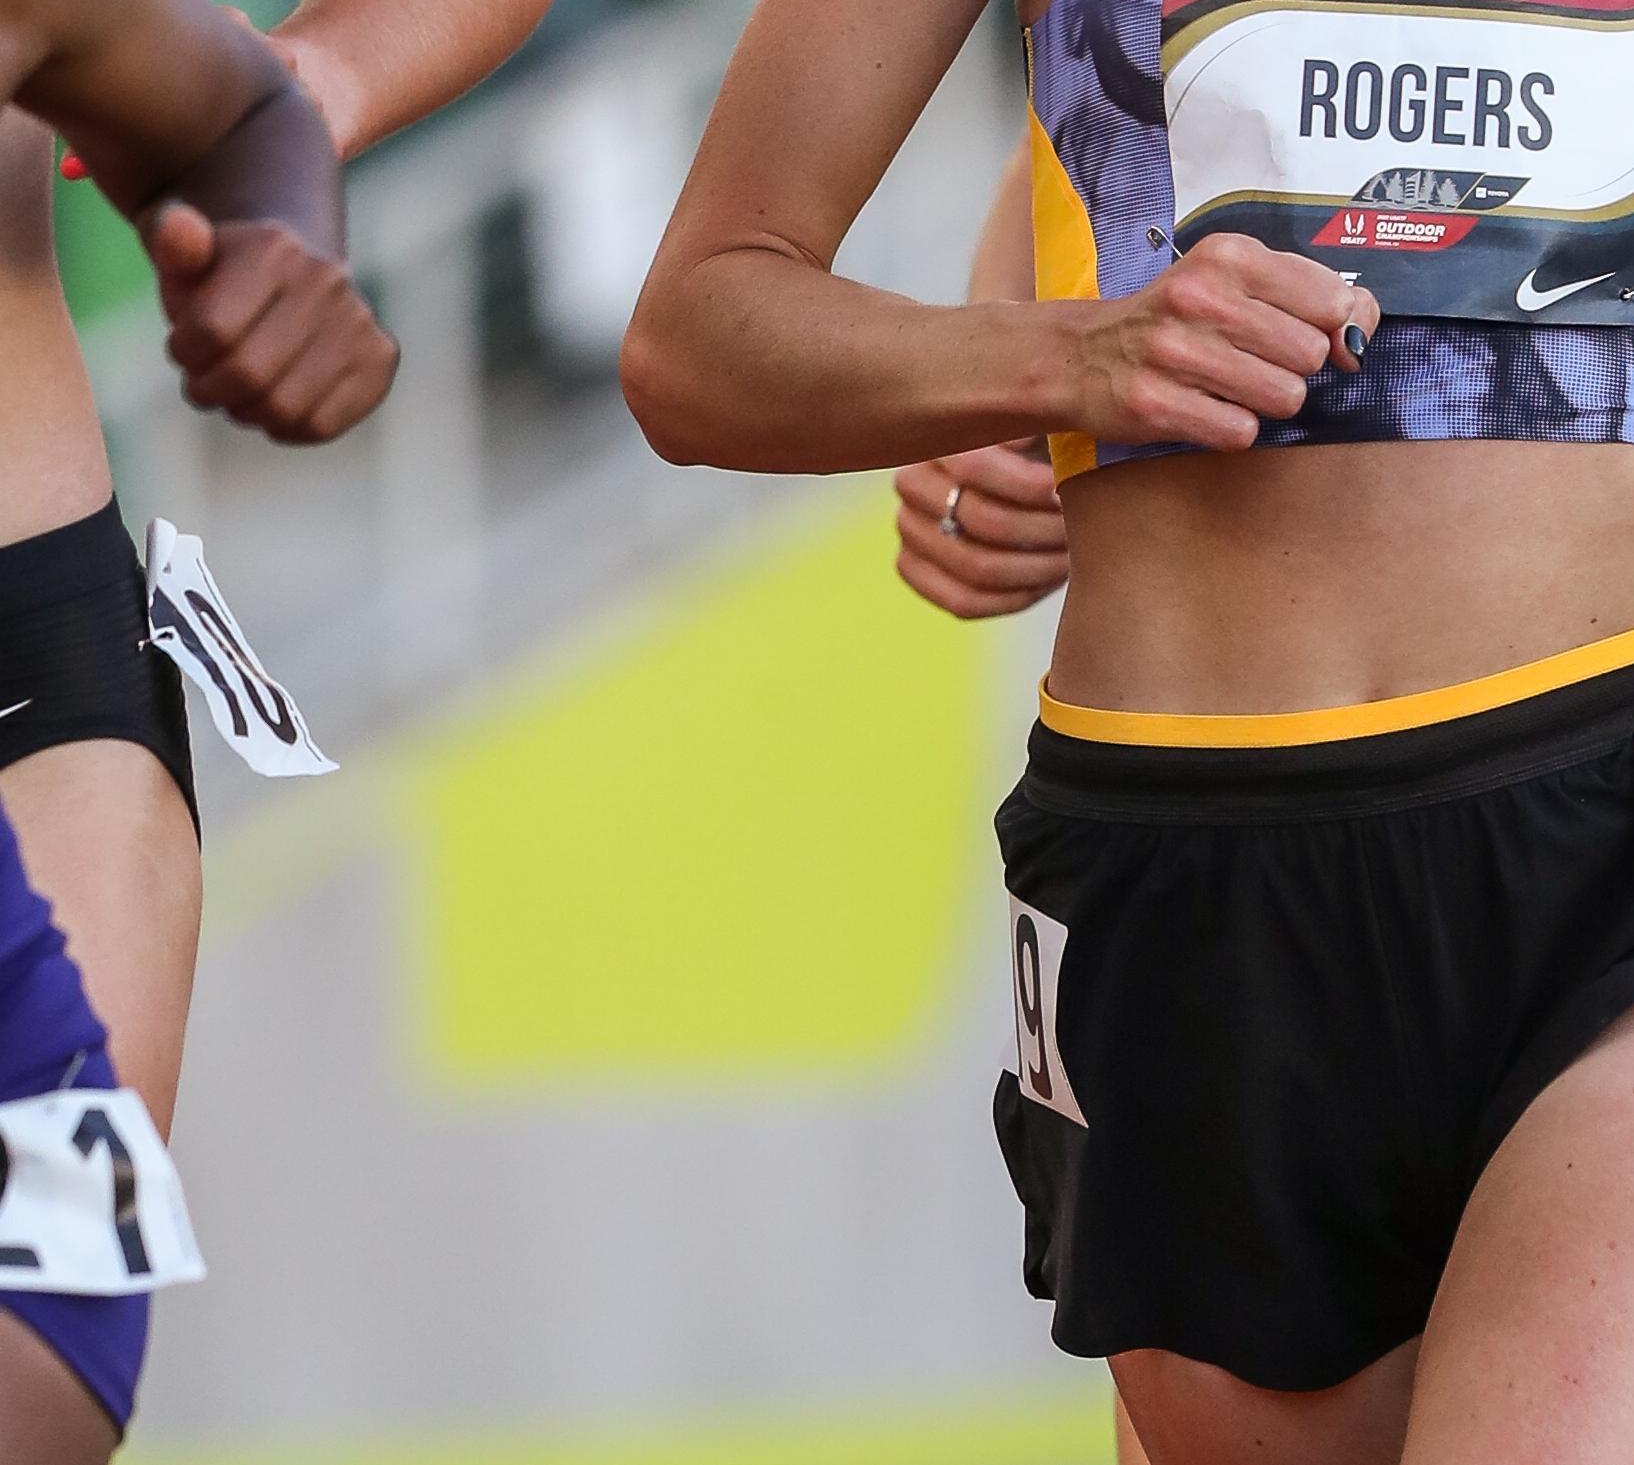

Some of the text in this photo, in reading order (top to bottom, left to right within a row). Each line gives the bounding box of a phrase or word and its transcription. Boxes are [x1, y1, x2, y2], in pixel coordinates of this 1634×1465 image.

[1300, 59, 1555, 151] ROGERS
[1340, 236, 1368, 246] USATF
[1376, 221, 1446, 237] OUTDOOR
[150, 586, 297, 746] 10
